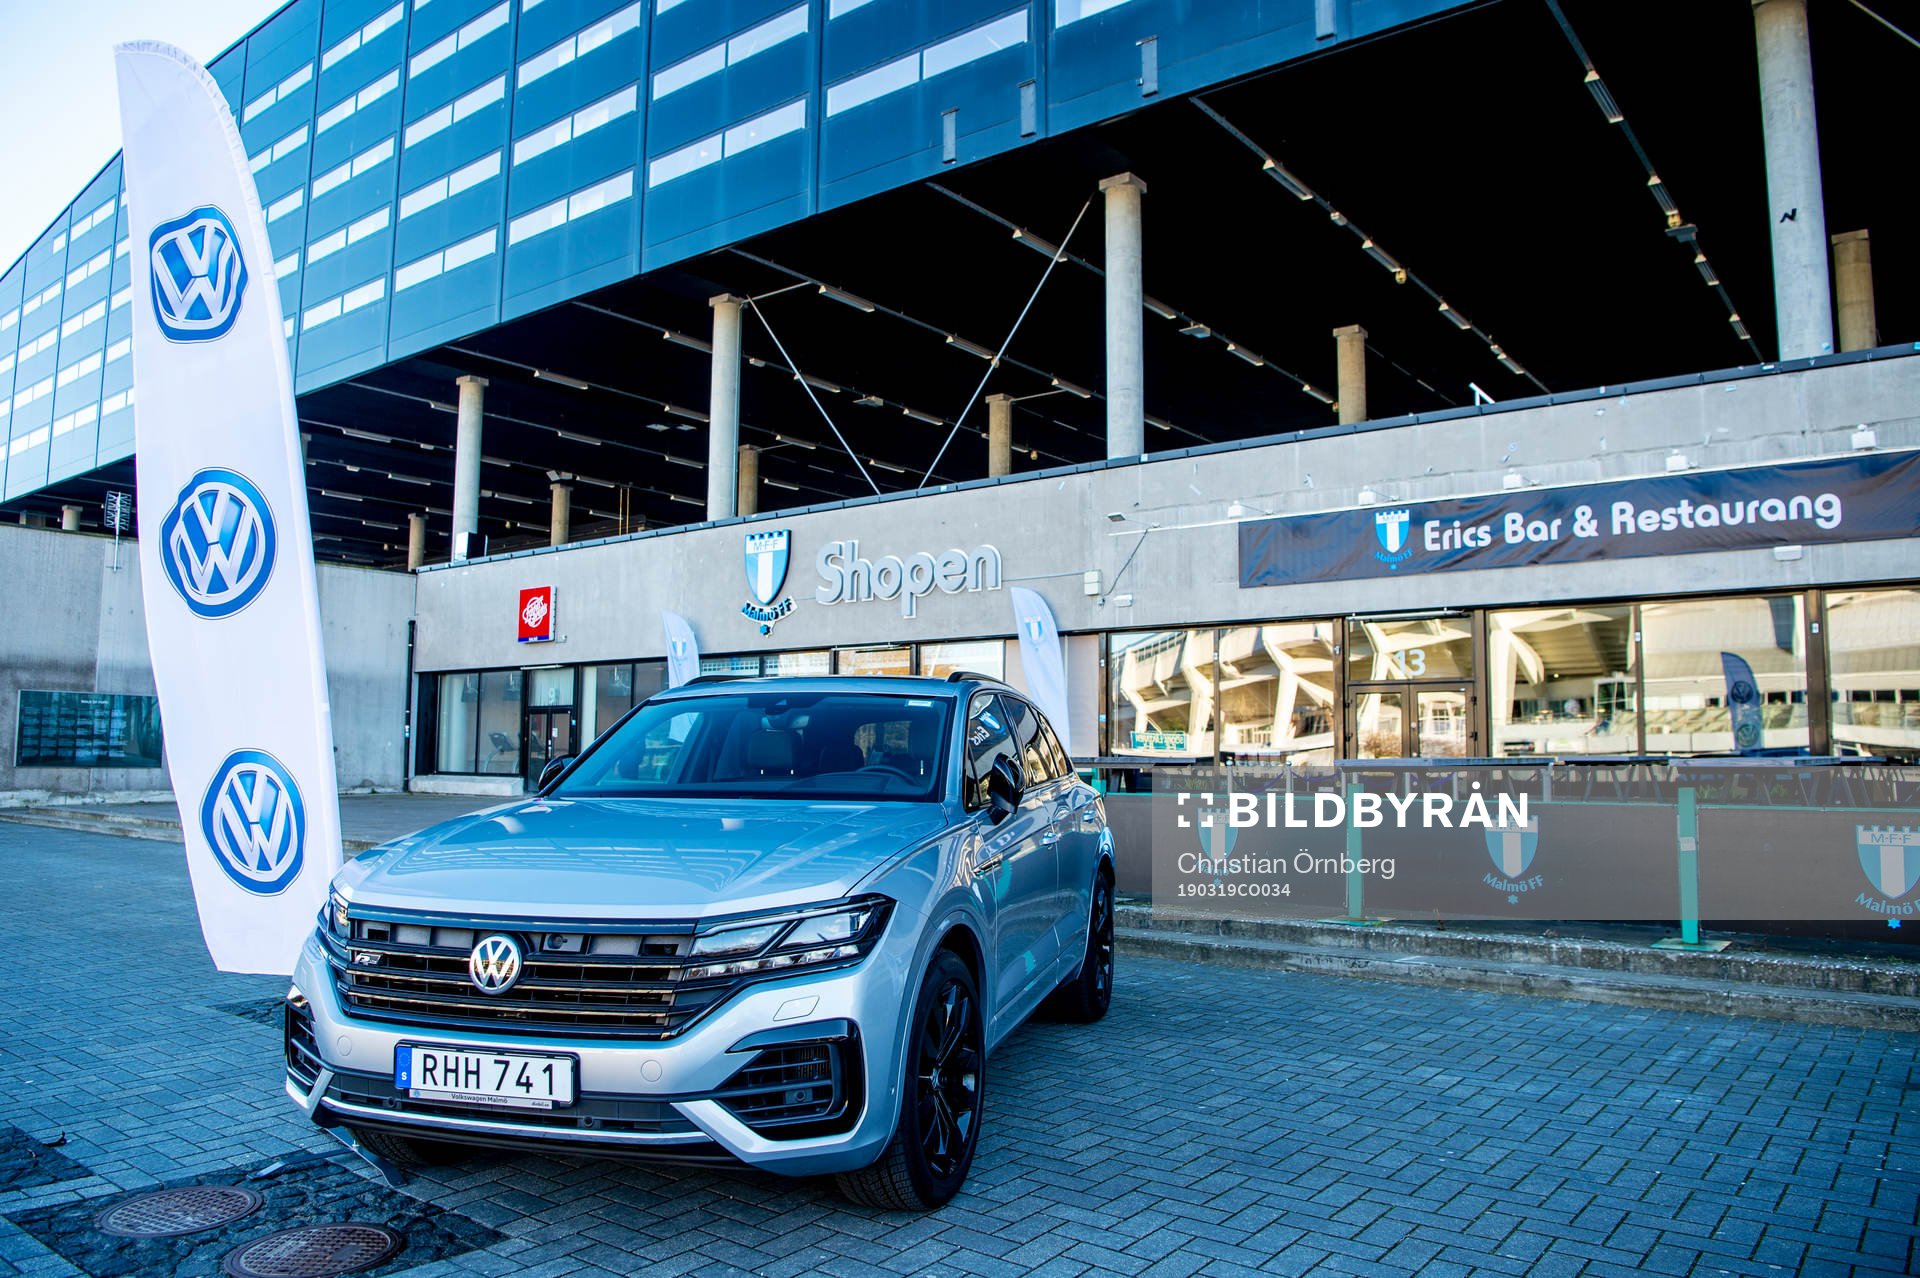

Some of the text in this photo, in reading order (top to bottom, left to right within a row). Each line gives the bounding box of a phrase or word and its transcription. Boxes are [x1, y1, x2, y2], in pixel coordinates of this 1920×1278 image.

[1424, 493, 1842, 551] Erics Bar & Restaurang
[815, 539, 1001, 619] Shopen
[1392, 648, 1425, 676] 13
[1482, 872, 1544, 893] Malmö FF
[1855, 892, 1914, 915] Malmö
[401, 1072, 408, 1081] S
[422, 1053, 554, 1096] RHH 741
[451, 1093, 508, 1104] Volkswagen Malmö
